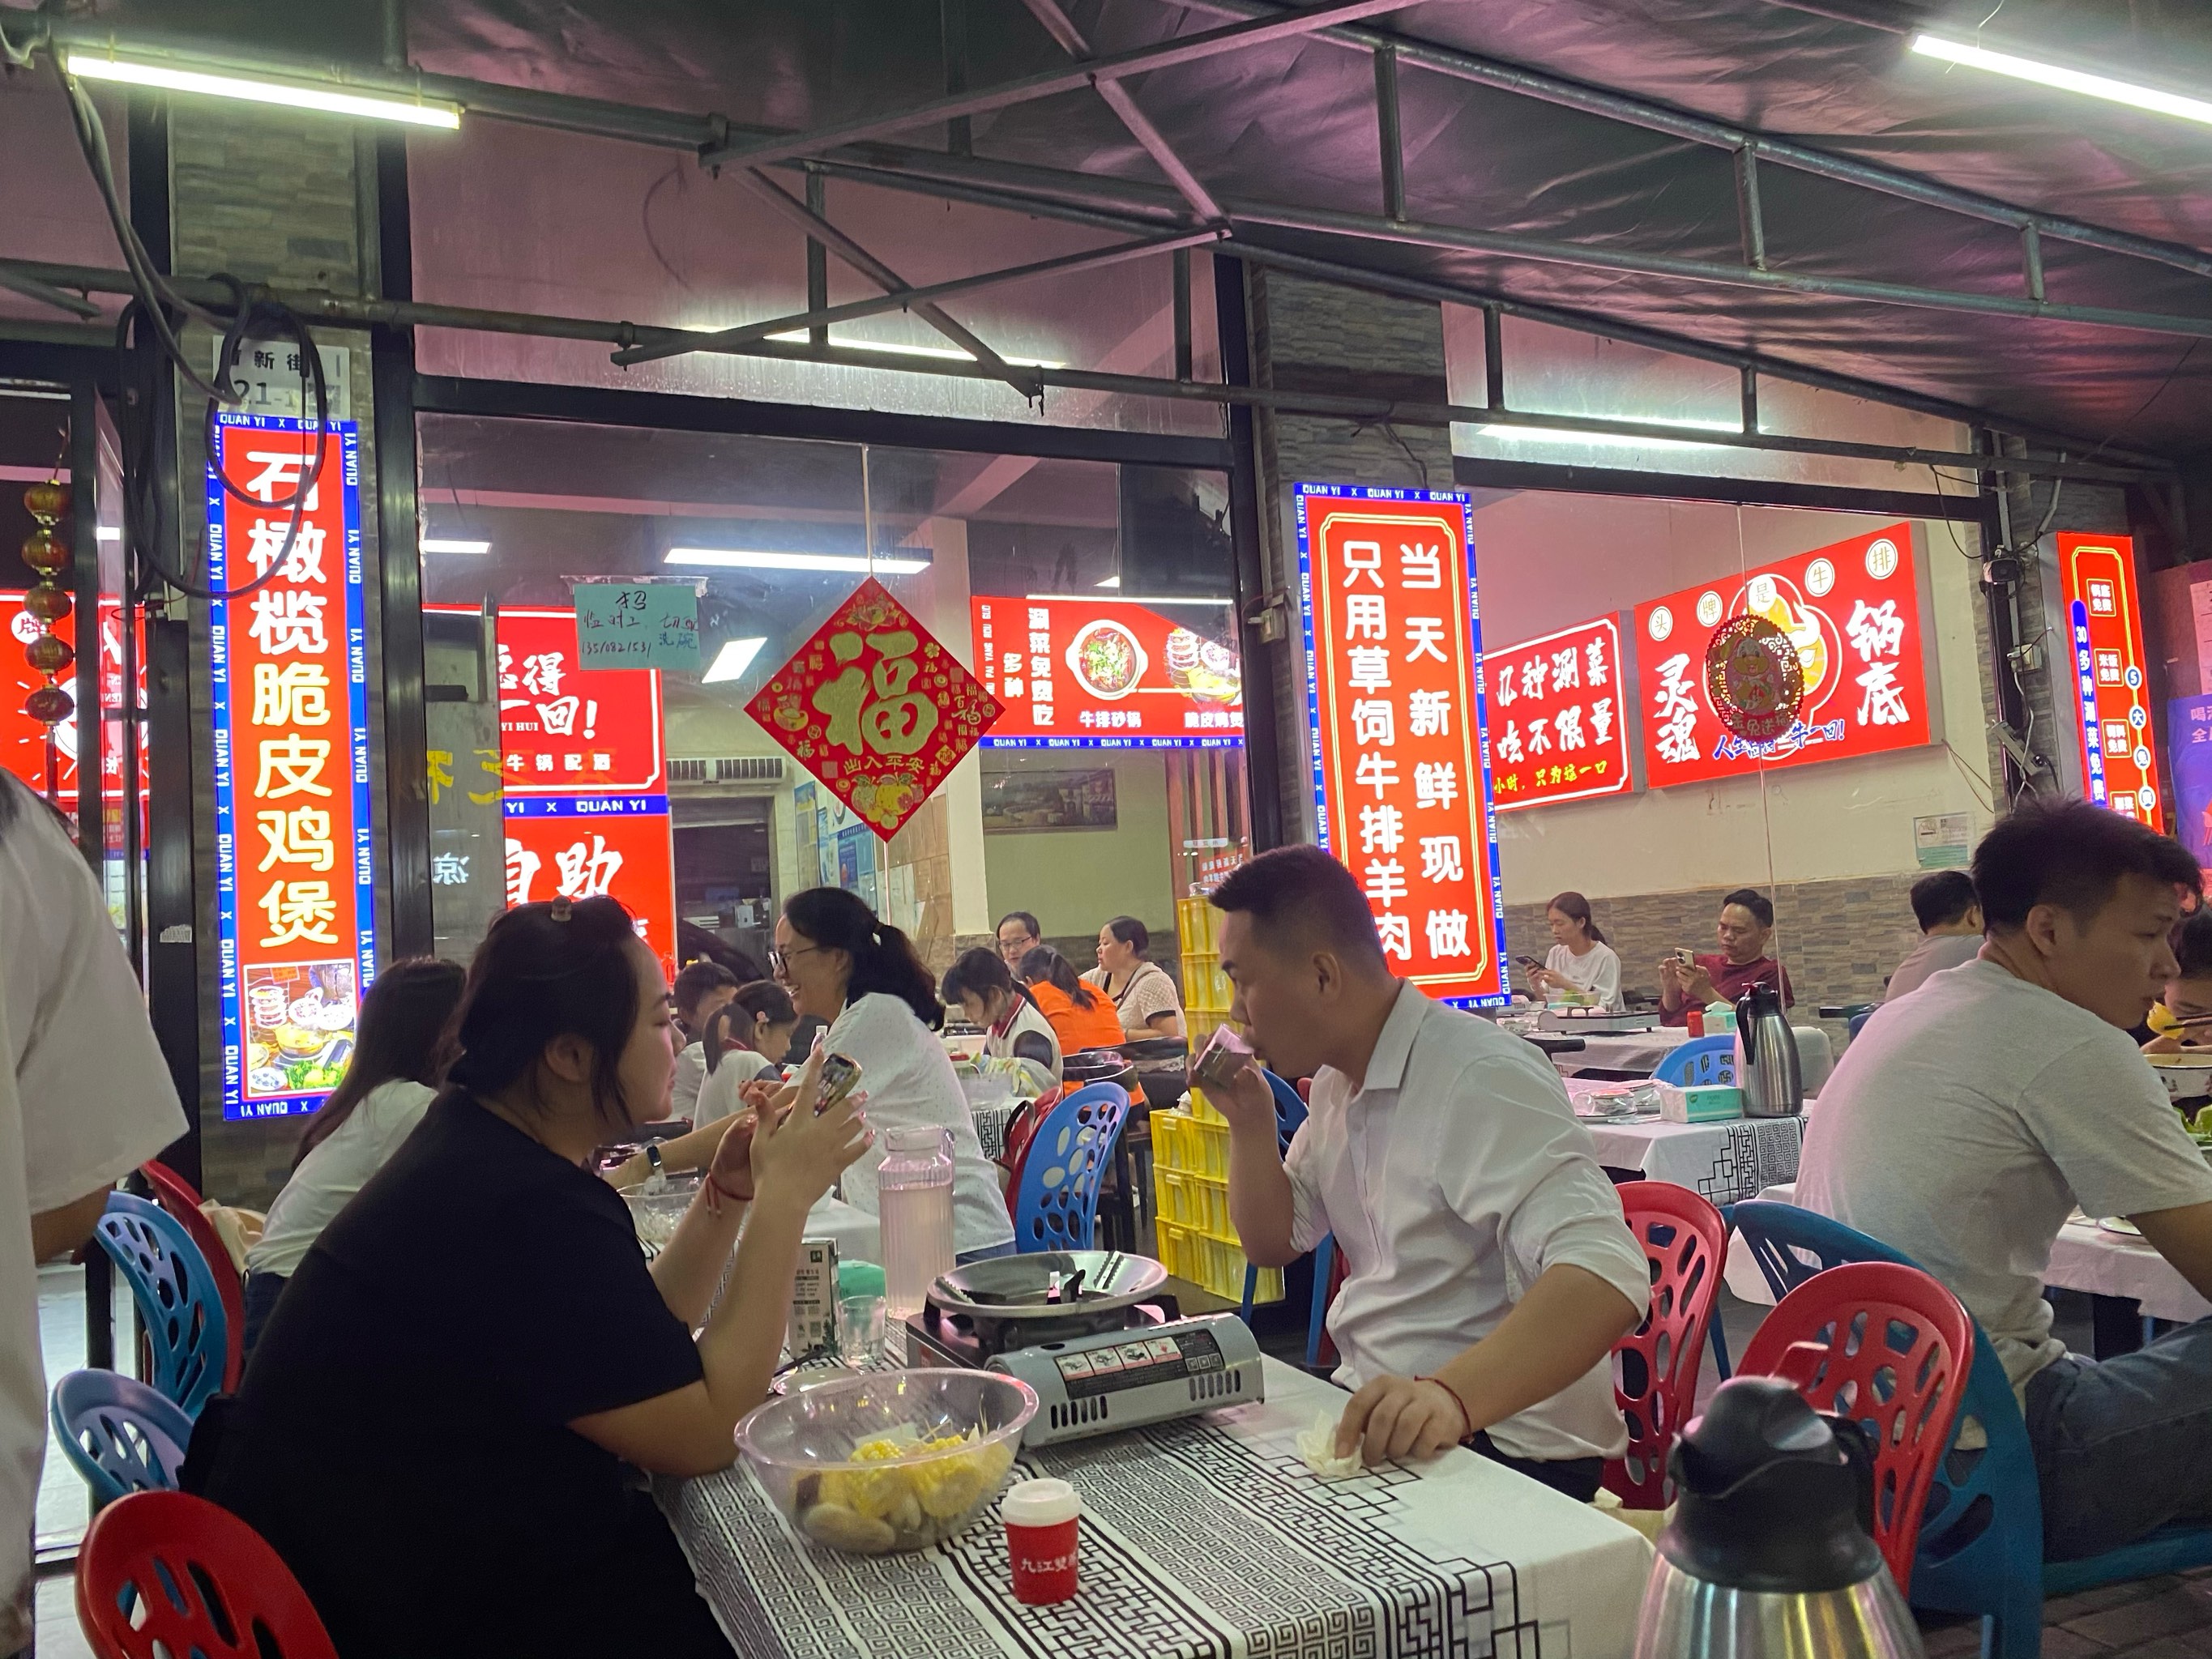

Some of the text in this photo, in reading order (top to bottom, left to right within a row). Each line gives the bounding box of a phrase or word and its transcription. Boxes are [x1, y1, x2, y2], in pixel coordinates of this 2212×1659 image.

[220, 414, 341, 431] QUAN YI X QUA YI
[344, 433, 357, 486] QUAN YI
[208, 497, 220, 506] X
[1302, 484, 1465, 501] QUAN YI X QUAN YI X QUAN YI
[209, 523, 223, 560] QUAN
[348, 530, 361, 584] QUAN YI
[211, 563, 223, 580] YI
[616, 591, 647, 610] 招
[212, 625, 226, 665] QUAN
[350, 629, 365, 684] QUAN YI
[1845, 599, 1910, 727] 锅底
[214, 668, 226, 683] YI
[246, 451, 338, 949] 石橄榄脆皮鸡煲
[812, 629, 939, 756] 福
[215, 702, 225, 710] X
[1654, 653, 1701, 765] 灵魂
[515, 722, 539, 731] HUI
[1497, 697, 1614, 764] 吃不限量
[215, 729, 228, 770] QUAN
[993, 739, 1243, 747] QUAN YI X QUAN YI X QUAN YI X QUAN YI X QUAN YI X
[1343, 540, 1412, 961] 只用草饲牛排羊肉
[1399, 543, 1471, 959] 当天新鲜现做
[354, 727, 368, 783] QUAN YI
[843, 755, 925, 774] 出入平安
[216, 773, 229, 787] YI
[218, 806, 229, 815] X
[506, 799, 647, 813] YI X QUAN YI
[218, 834, 233, 874] QUAN
[357, 828, 371, 885] QUAN YI
[219, 877, 233, 892] YI
[220, 911, 232, 920] X
[360, 931, 373, 945] YI
[221, 939, 235, 978] QUAN
[223, 982, 235, 998] YI
[224, 1017, 236, 1026] X
[224, 1045, 238, 1085] QUAN
[226, 1089, 238, 1105] YI
